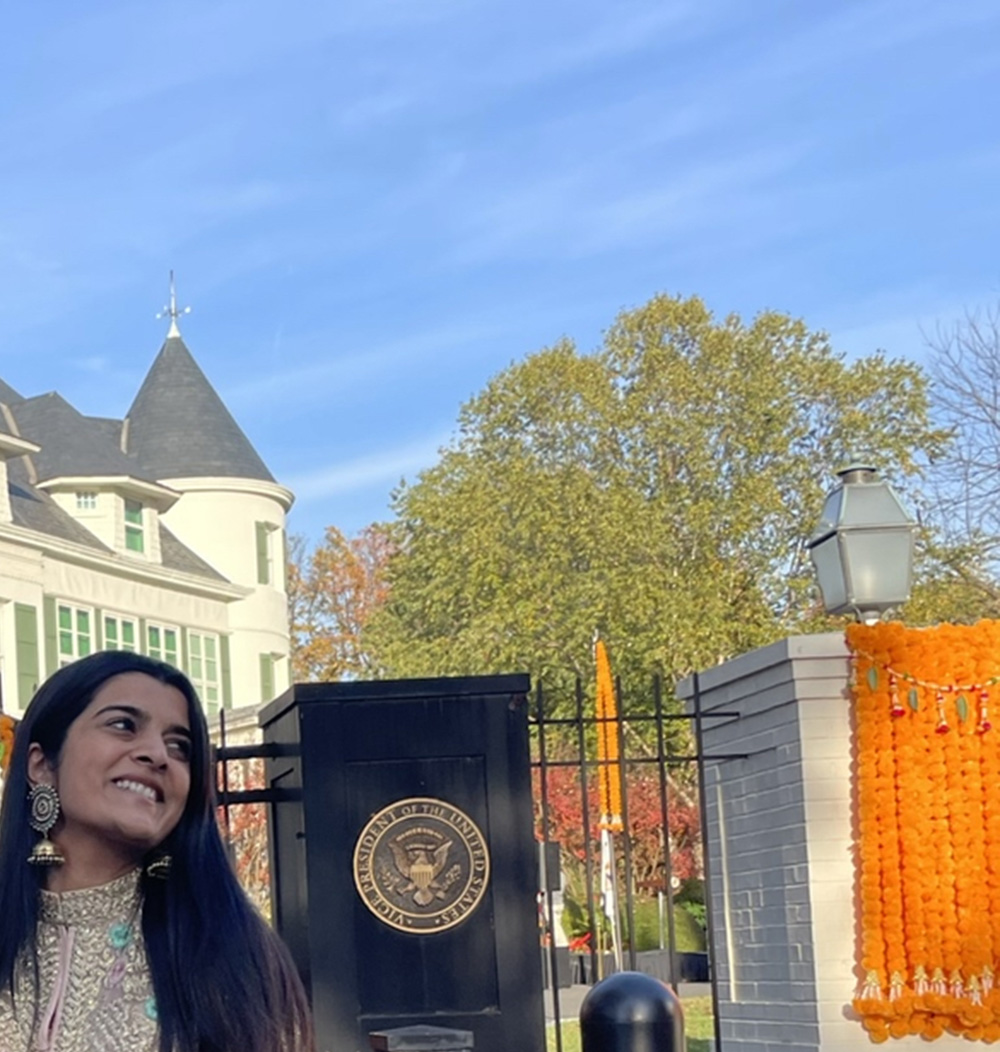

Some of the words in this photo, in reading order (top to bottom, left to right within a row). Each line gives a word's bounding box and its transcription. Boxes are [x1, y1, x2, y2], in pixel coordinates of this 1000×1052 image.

[401, 805, 418, 815] OF
[421, 804, 446, 816] THE
[359, 811, 397, 892] PRESIDENT
[449, 813, 485, 872] UNITED
[371, 895, 404, 925] VICE
[441, 877, 483, 922] STATES
